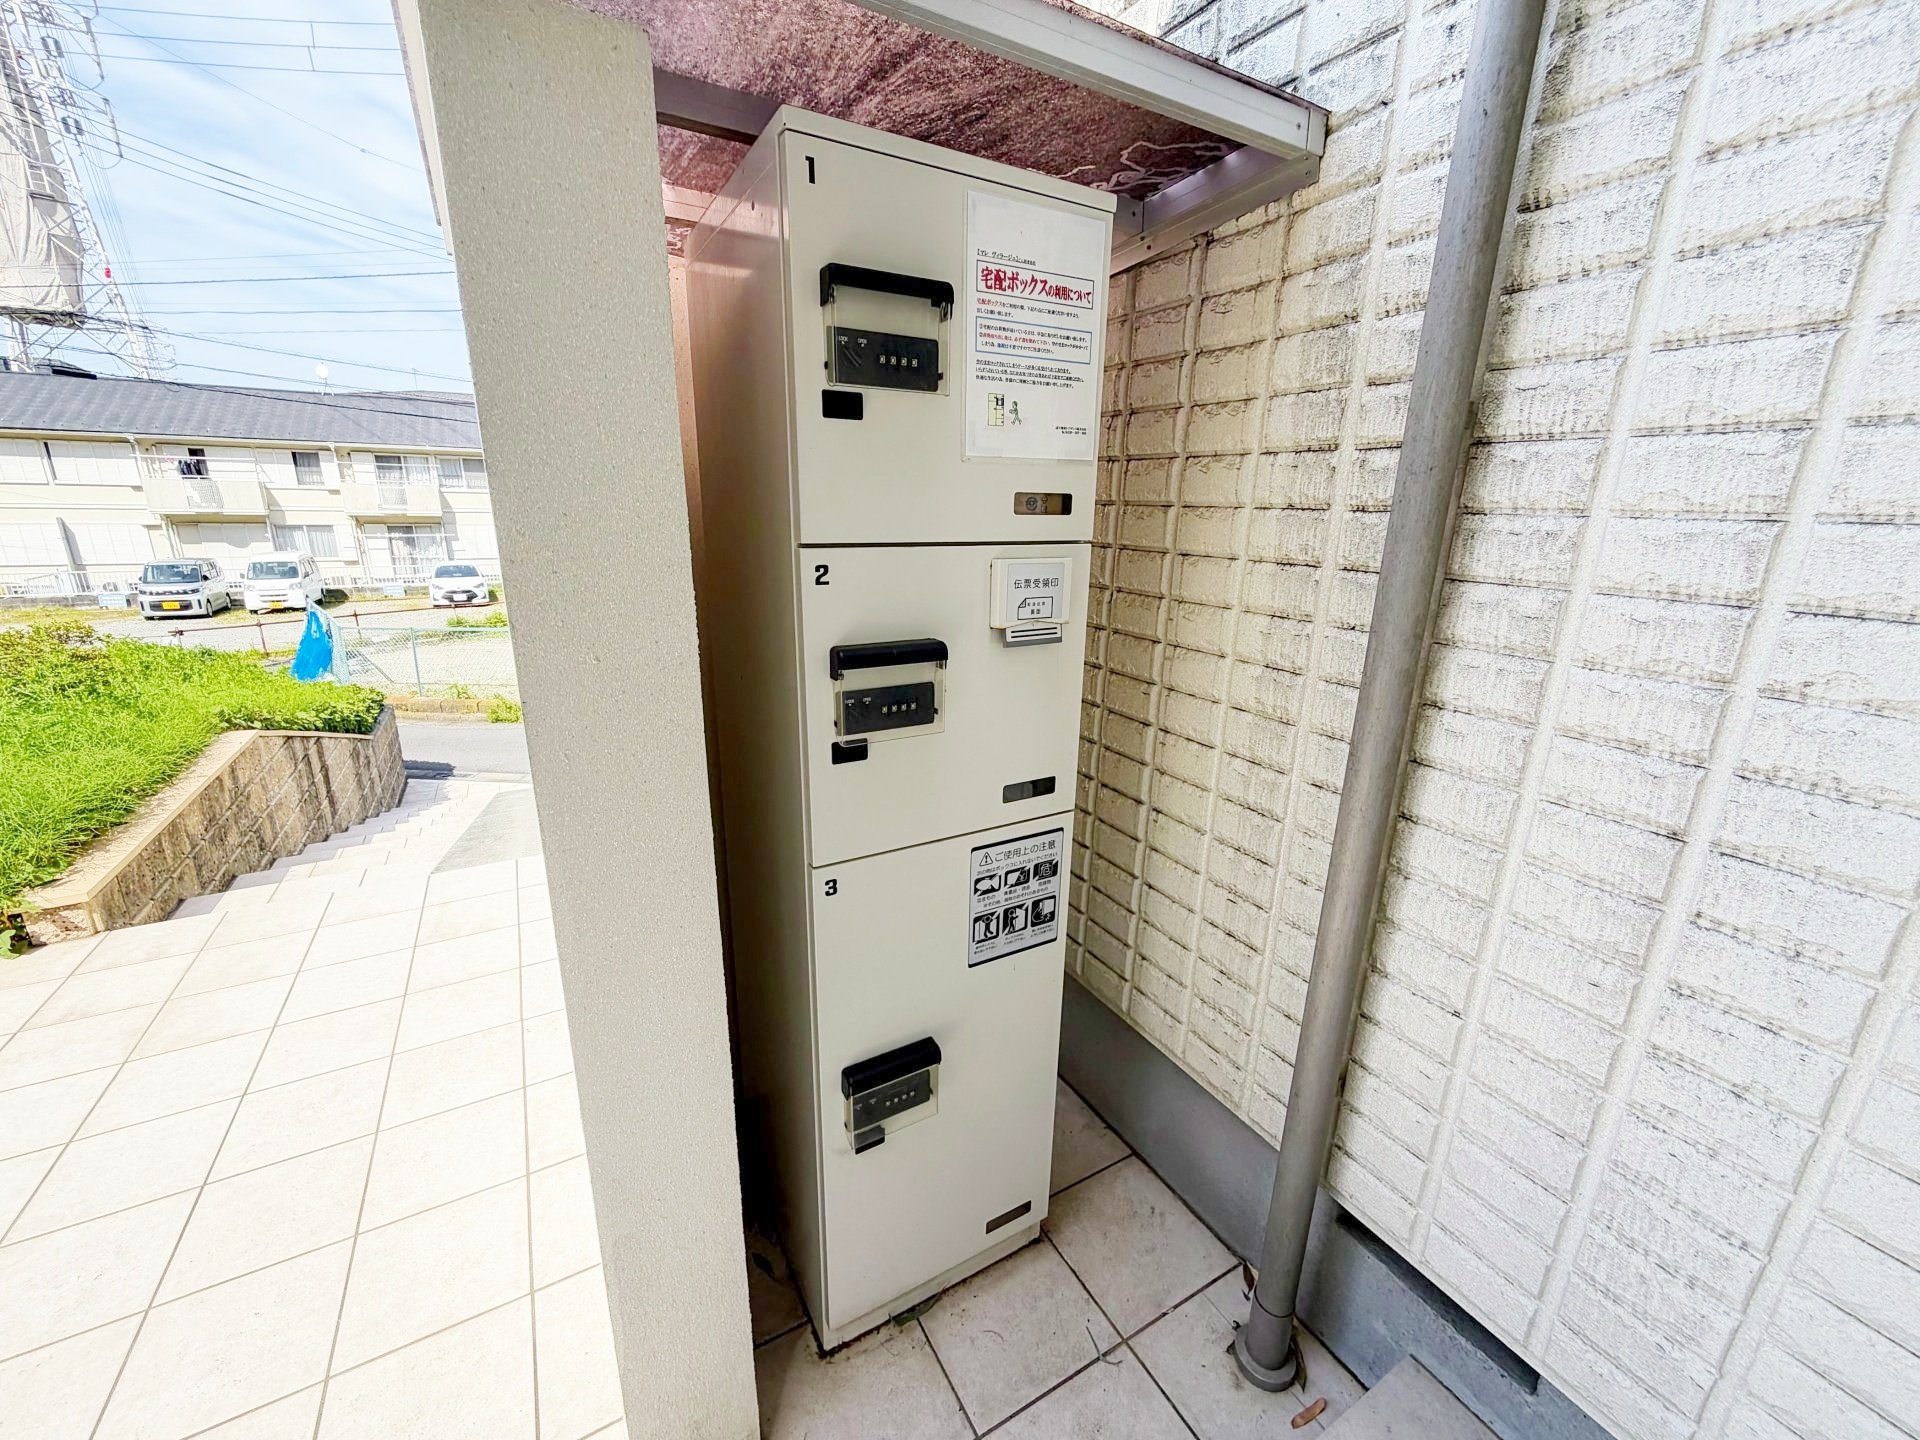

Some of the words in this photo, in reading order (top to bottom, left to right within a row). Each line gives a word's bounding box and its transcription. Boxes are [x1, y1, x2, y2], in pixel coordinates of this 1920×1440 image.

[805, 155, 816, 185] 1
[980, 265, 1092, 304] 宅配ボックスの利用について
[815, 565, 830, 586] 2
[1014, 577, 1060, 590] 伝票受領印
[994, 839, 1057, 863] ご使用上の注意
[825, 879, 838, 897] 3
